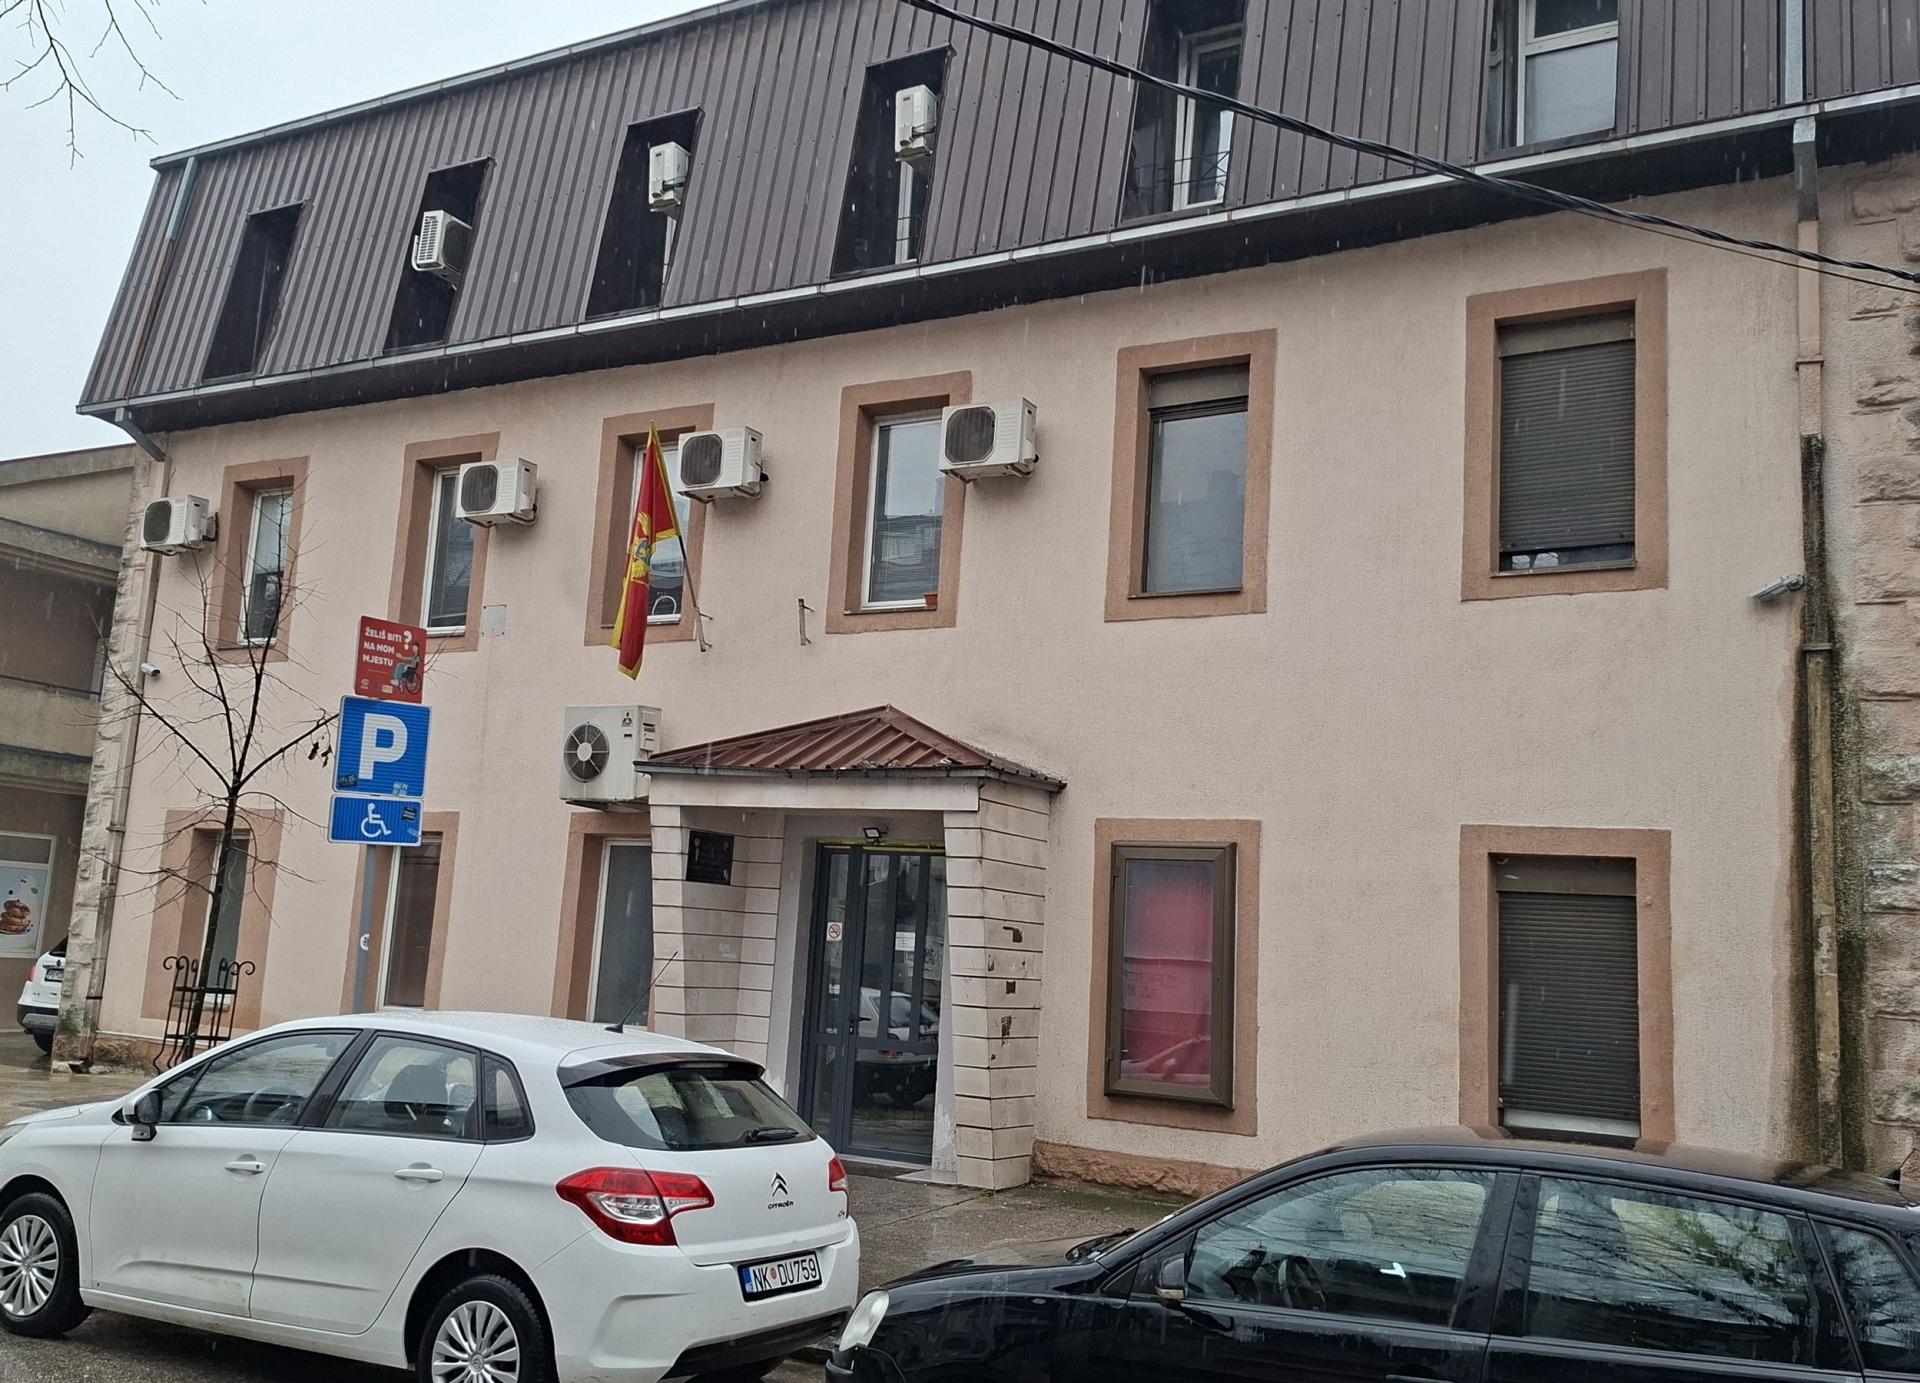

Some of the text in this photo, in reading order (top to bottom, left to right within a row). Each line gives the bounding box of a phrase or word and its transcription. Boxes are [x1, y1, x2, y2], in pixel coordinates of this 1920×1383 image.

[364, 626, 386, 639] ŽELIŠ
[387, 632, 402, 643] BITI
[363, 641, 395, 654] NA MOM
[362, 654, 393, 666] MJESTU
[358, 712, 409, 780] P
[752, 1266, 772, 1291] NK
[778, 1257, 818, 1286] DU759
